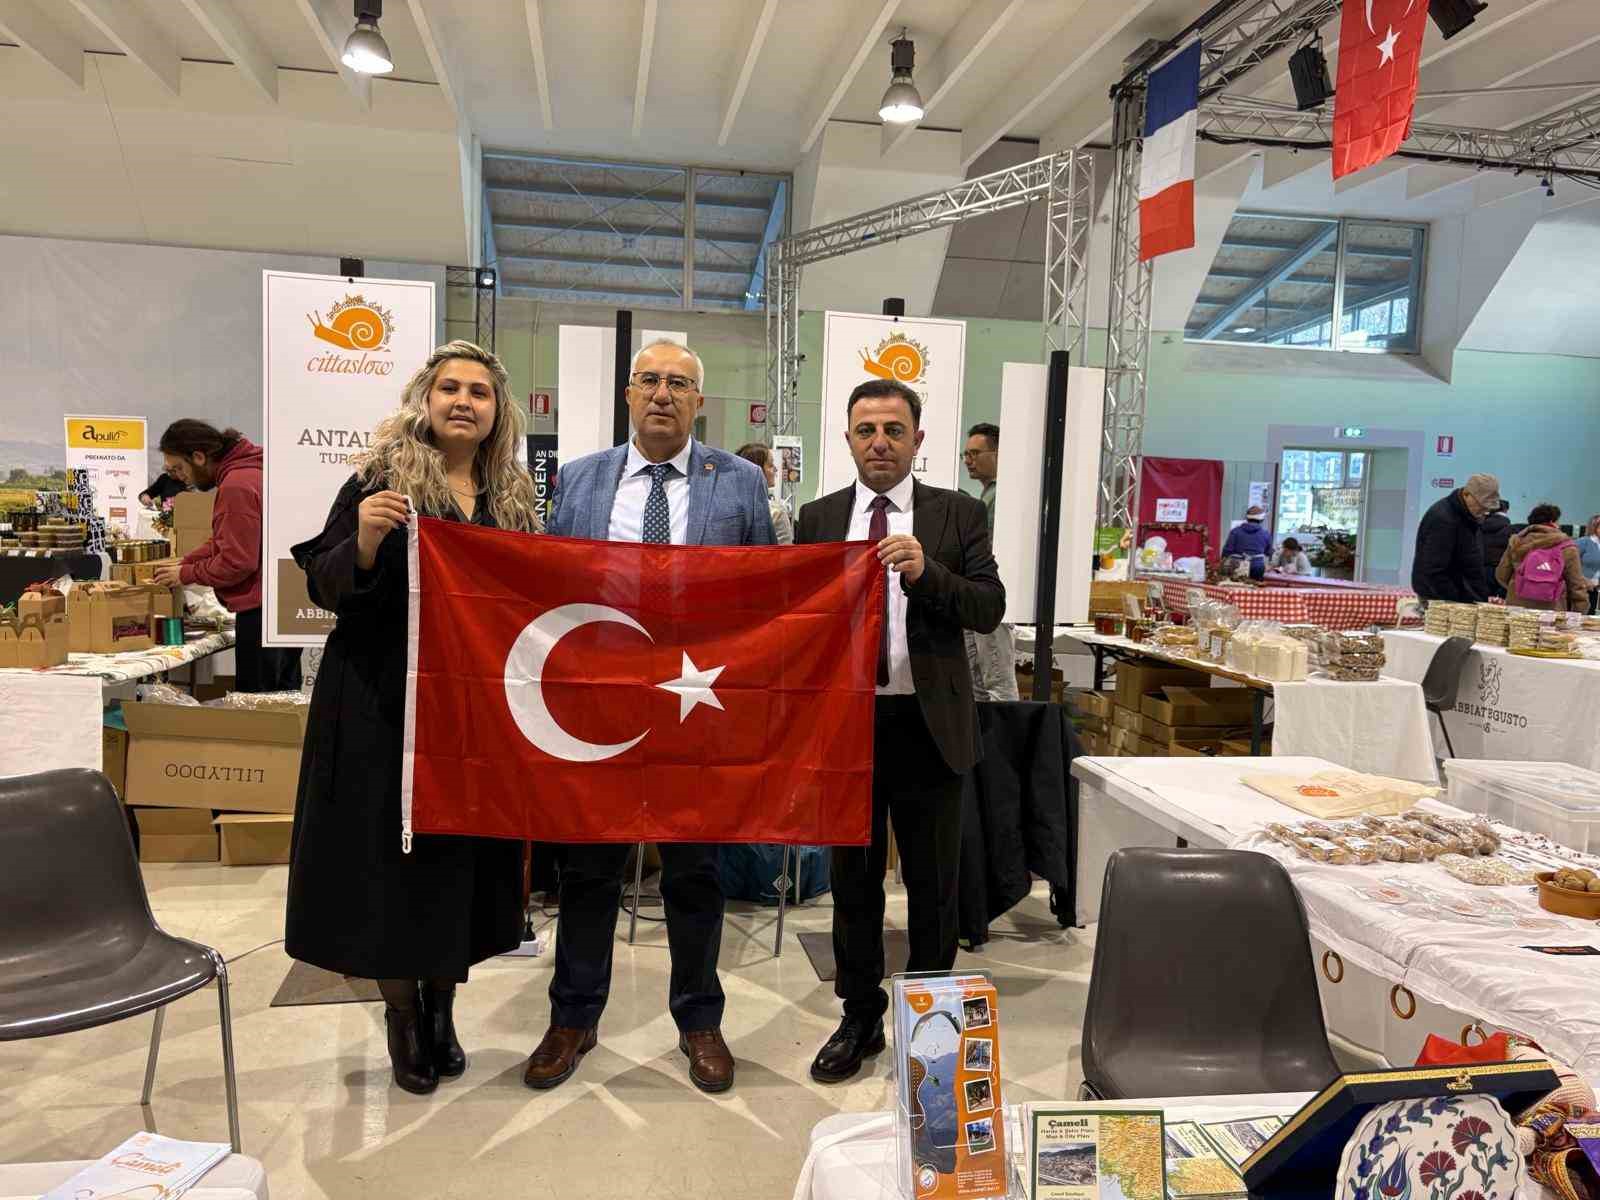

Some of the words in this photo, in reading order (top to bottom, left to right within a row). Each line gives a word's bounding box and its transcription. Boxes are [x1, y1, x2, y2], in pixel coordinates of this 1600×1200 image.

[306, 352, 395, 376] cittaslow
[297, 428, 374, 449] ANTAL
[536, 450, 547, 458] AN
[534, 458, 547, 535] ANGEN
[165, 763, 265, 784] LILLYDOO
